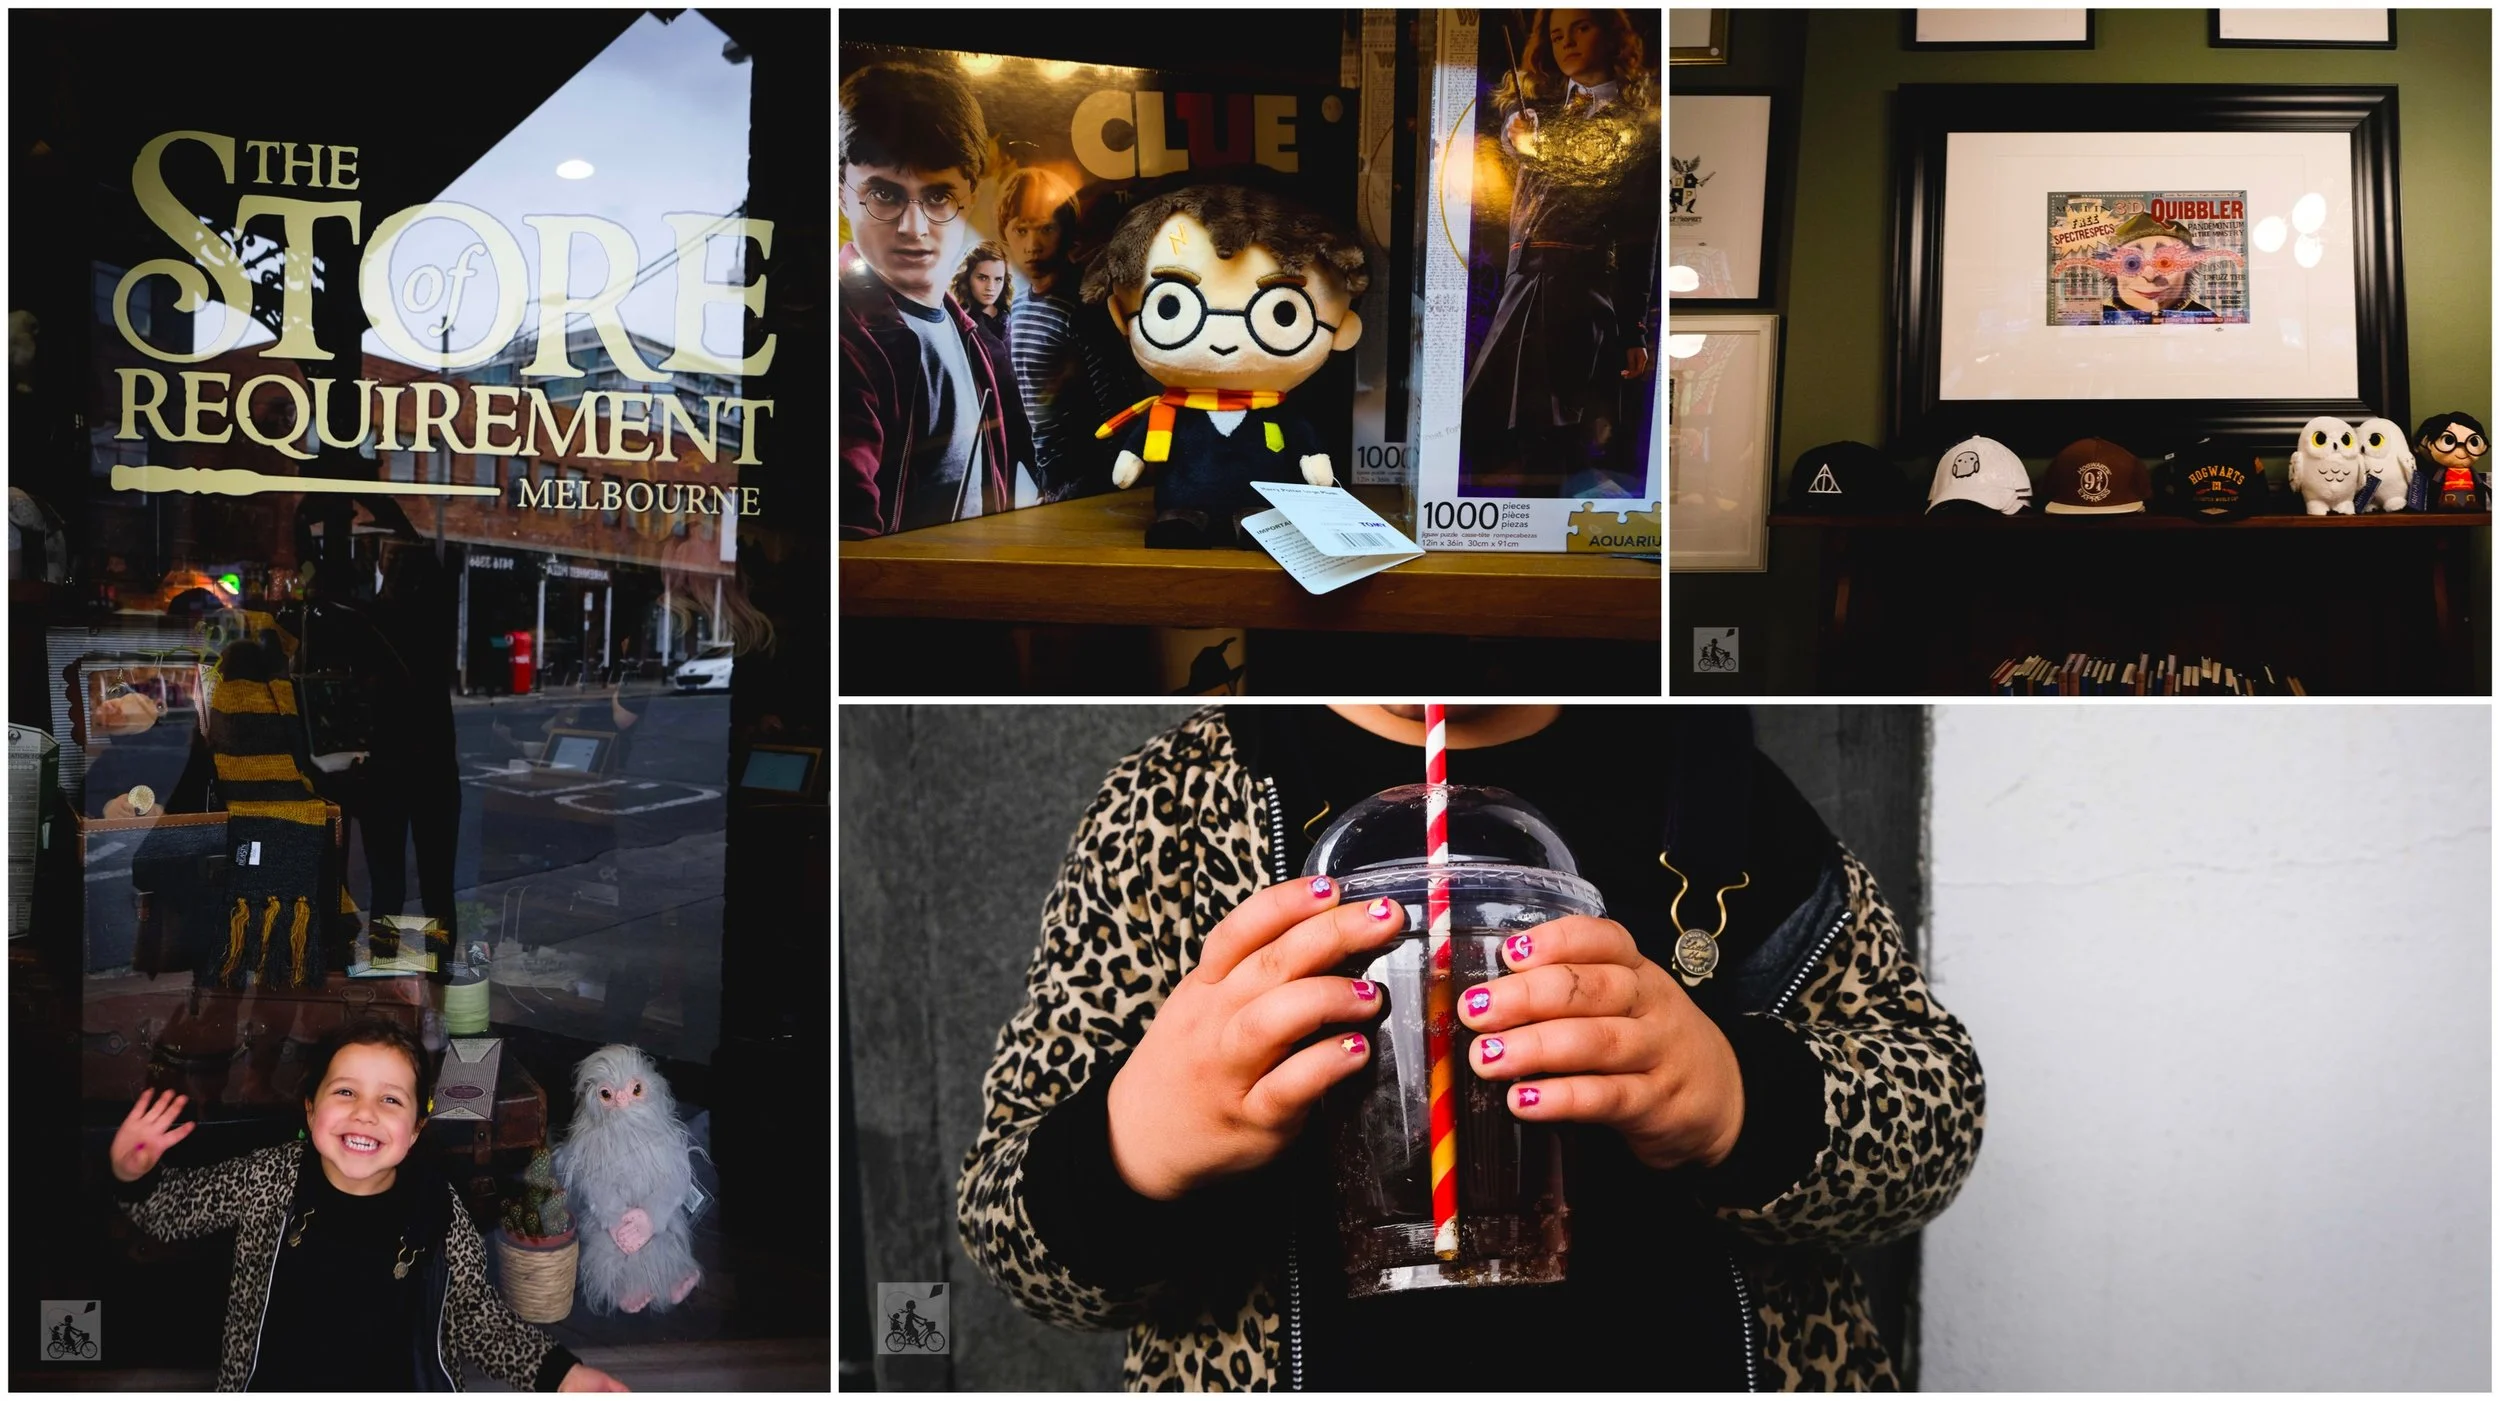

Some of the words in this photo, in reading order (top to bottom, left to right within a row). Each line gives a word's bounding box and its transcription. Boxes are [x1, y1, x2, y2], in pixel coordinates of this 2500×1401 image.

[1071, 89, 1299, 180] CLUE
[244, 139, 361, 191] THE
[2114, 200, 2145, 216] 3D
[2151, 199, 2243, 230] QUIBBLER
[2072, 214, 2100, 230] FREE
[2188, 221, 2245, 231] PANDEMONIUM
[2054, 223, 2115, 245] SPECTRESPECS
[112, 129, 778, 384] STORE
[402, 241, 488, 337] of
[113, 367, 775, 467] REQUIREMENT
[2188, 465, 2246, 485] HOGWARTS
[518, 477, 762, 517] MELBOURNE
[1502, 502, 1531, 511] pieces
[1423, 501, 1499, 530] 1000
[1501, 519, 1529, 530] piezas
[1502, 510, 1530, 520] pièces
[1422, 539, 1438, 547] 12in
[1447, 539, 1463, 547] 36in
[1497, 540, 1519, 548] 91cm
